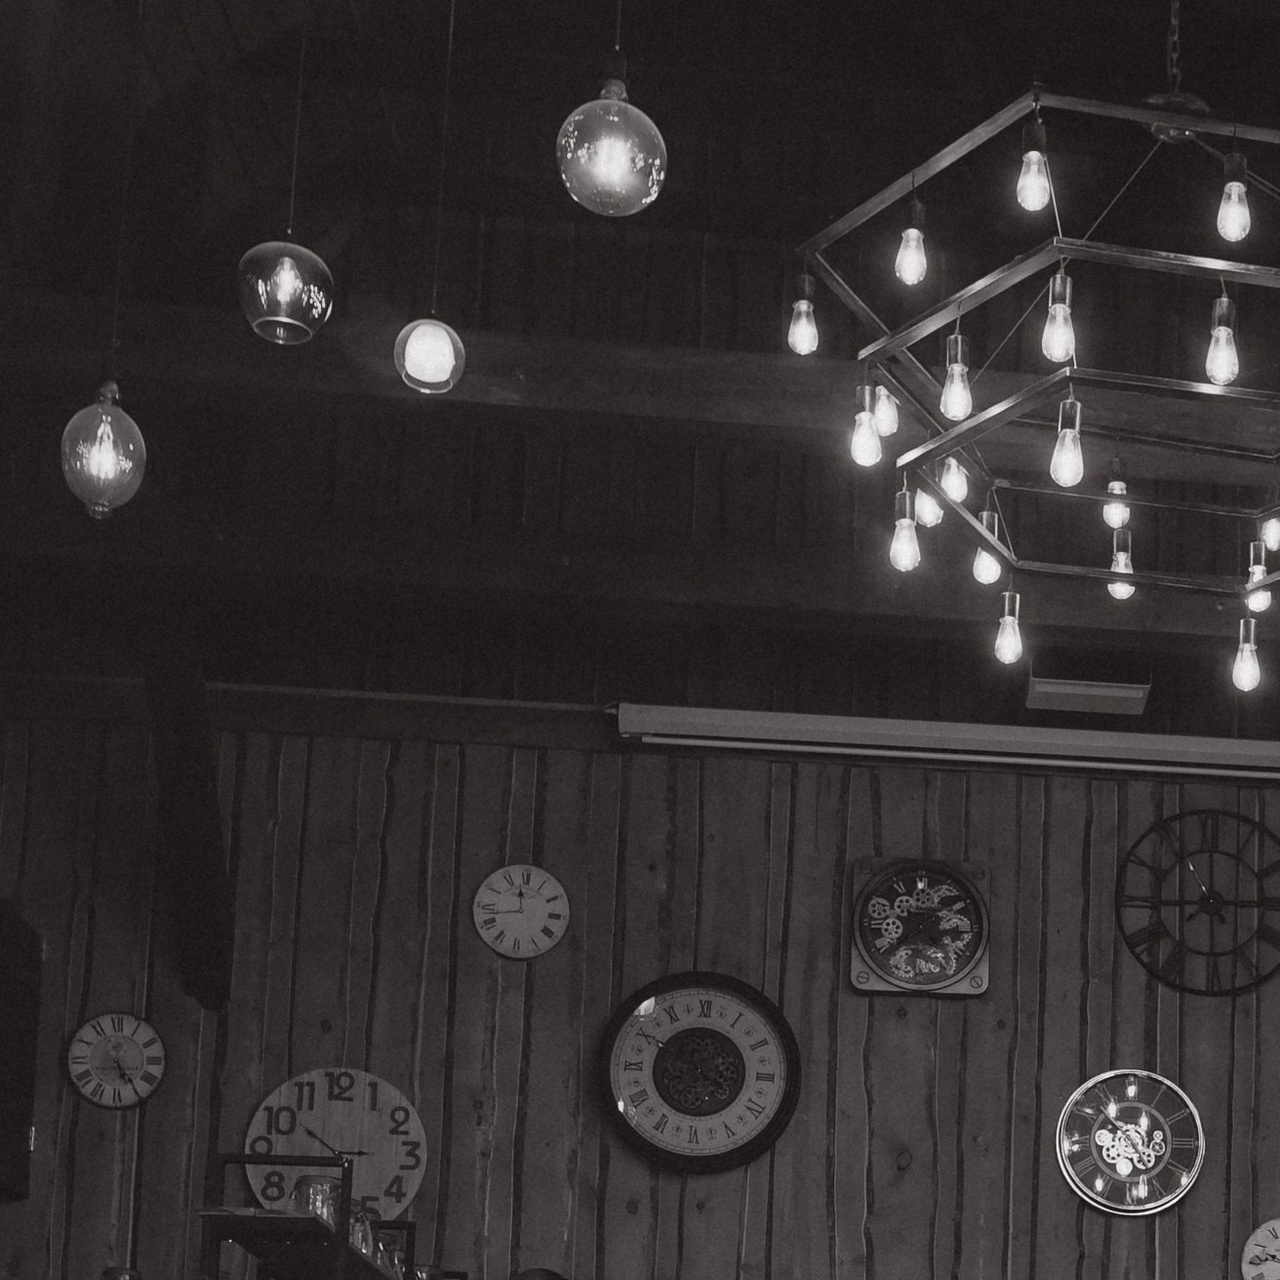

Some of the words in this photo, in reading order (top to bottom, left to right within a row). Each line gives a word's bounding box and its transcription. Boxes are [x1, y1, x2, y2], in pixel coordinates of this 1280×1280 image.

[664, 1006, 680, 1024] XI
[698, 1000, 712, 1018] XII
[730, 1012, 743, 1027] I
[636, 1027, 657, 1045] X
[749, 1039, 768, 1051] II
[624, 1060, 643, 1071] IX
[324, 1072, 355, 1102] 12
[756, 1071, 775, 1083] III
[294, 1082, 315, 1111] 11
[368, 1083, 377, 1111] 1
[629, 1088, 649, 1108] VIII
[745, 1098, 766, 1120] IV
[264, 1107, 295, 1135] 10
[389, 1107, 410, 1135] 2
[652, 1113, 667, 1133] VII
[724, 1121, 736, 1139] V
[688, 1125, 700, 1144] VI
[400, 1141, 421, 1170] 3
[261, 1171, 285, 1201] 8
[384, 1176, 406, 1203] 4
[361, 1196, 381, 1220] 5
